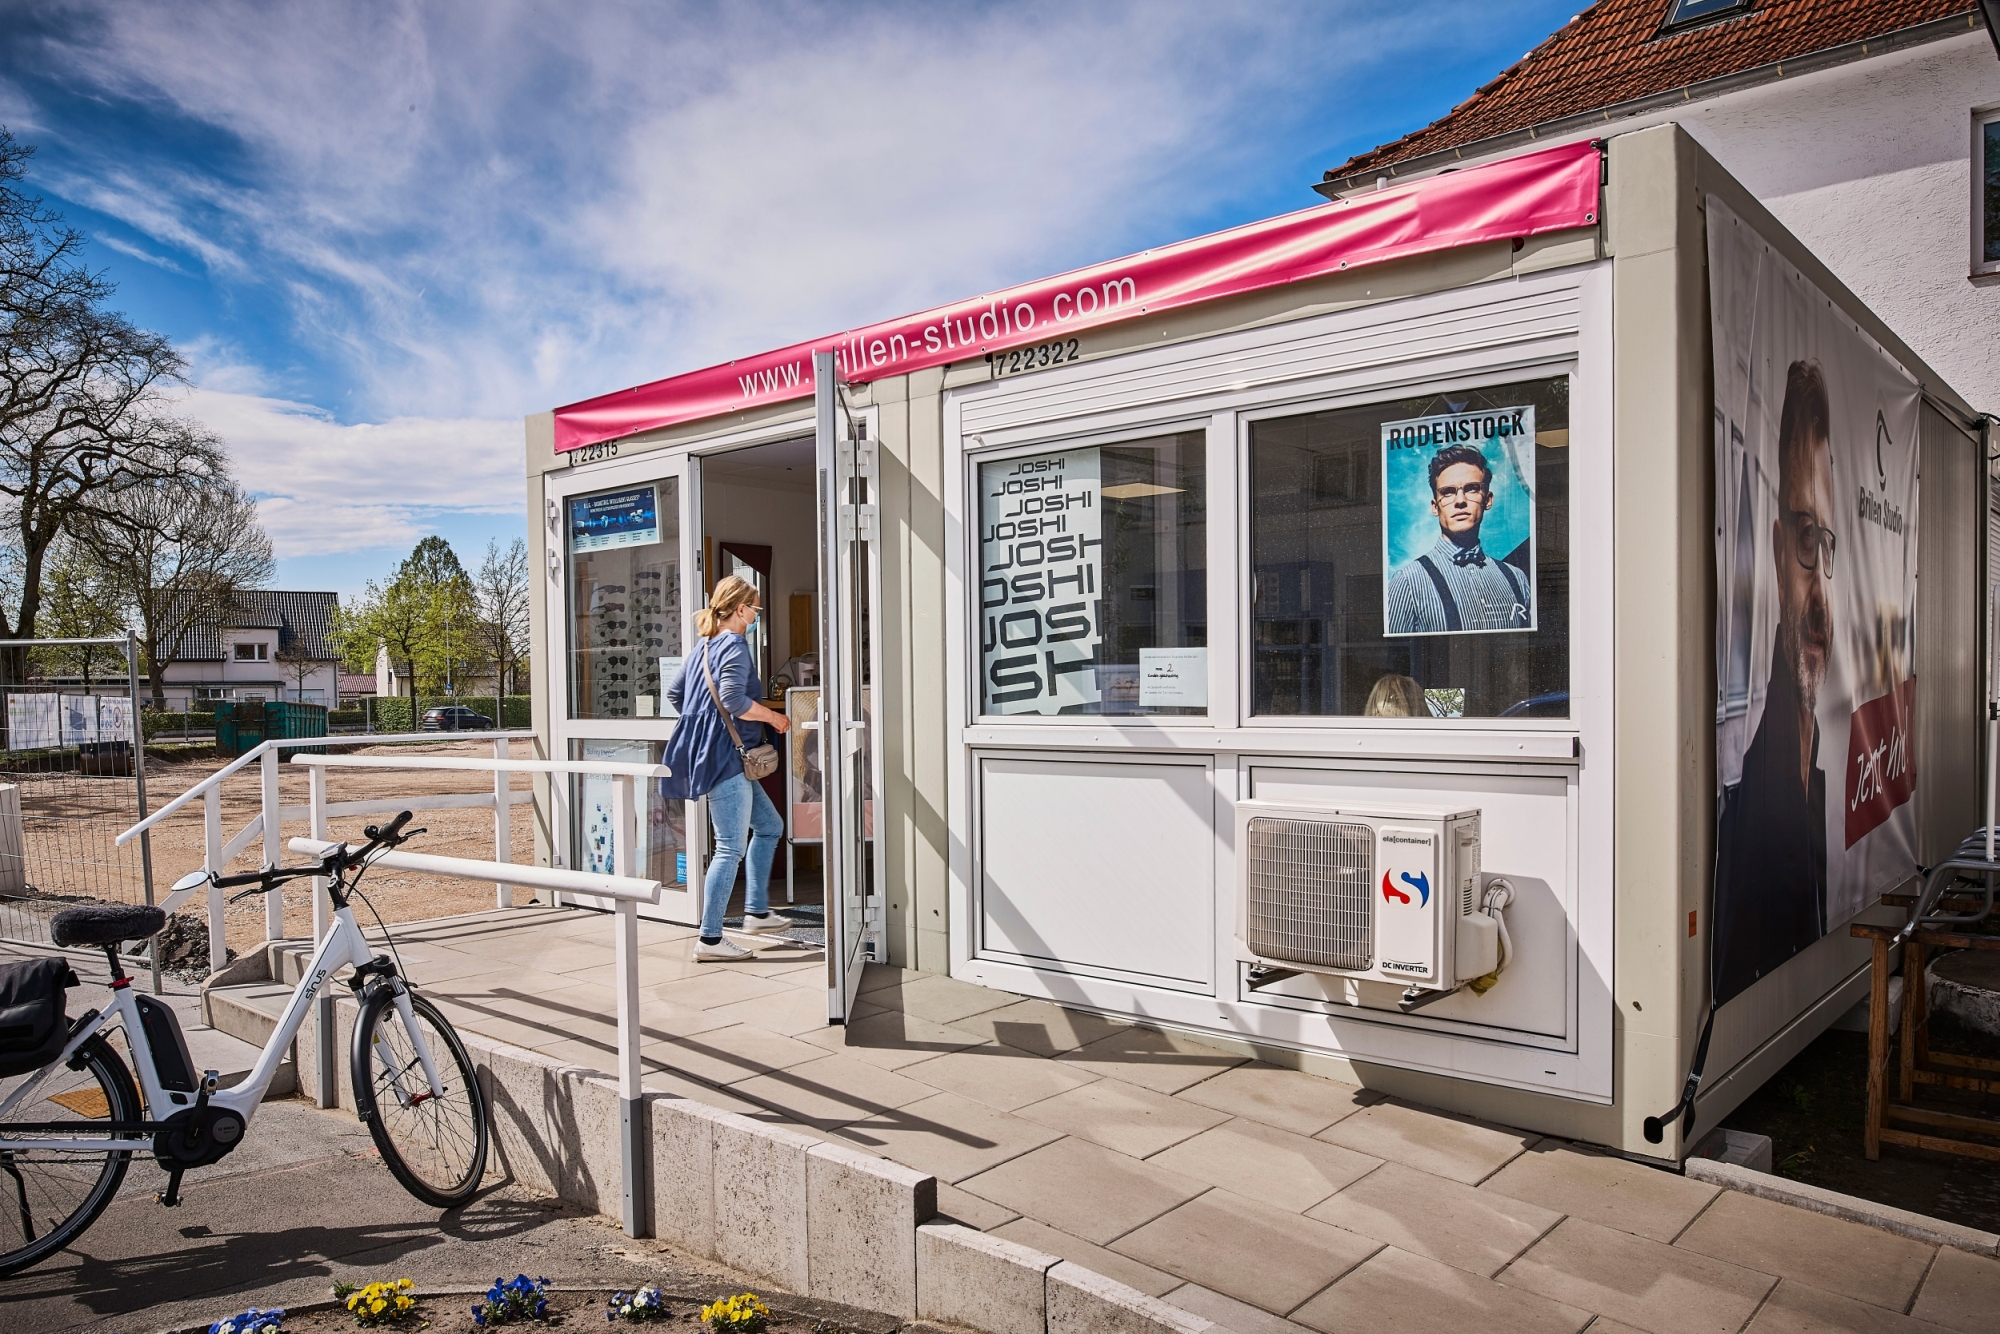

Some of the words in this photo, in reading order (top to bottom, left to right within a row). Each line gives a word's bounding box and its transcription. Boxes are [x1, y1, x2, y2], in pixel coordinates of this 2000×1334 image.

[738, 275, 1136, 399] www.illen-studio.com
[996, 338, 1079, 375] 722322
[1390, 415, 1525, 450] RODENSTOCK
[1009, 458, 1064, 476] JOSHI
[991, 475, 1062, 497] JOSHI
[1005, 491, 1091, 517] JOSHI
[1859, 486, 1881, 525] Brillen
[1883, 499, 1903, 536] Studio
[983, 514, 1066, 543] JOSHI
[984, 600, 1101, 652] JOS
[1167, 663, 1174, 672] 2
[1382, 835, 1431, 846] ela[container]
[1382, 961, 1392, 969] DC
[1392, 963, 1428, 973] INVERTER
[305, 969, 327, 1001] sinus
